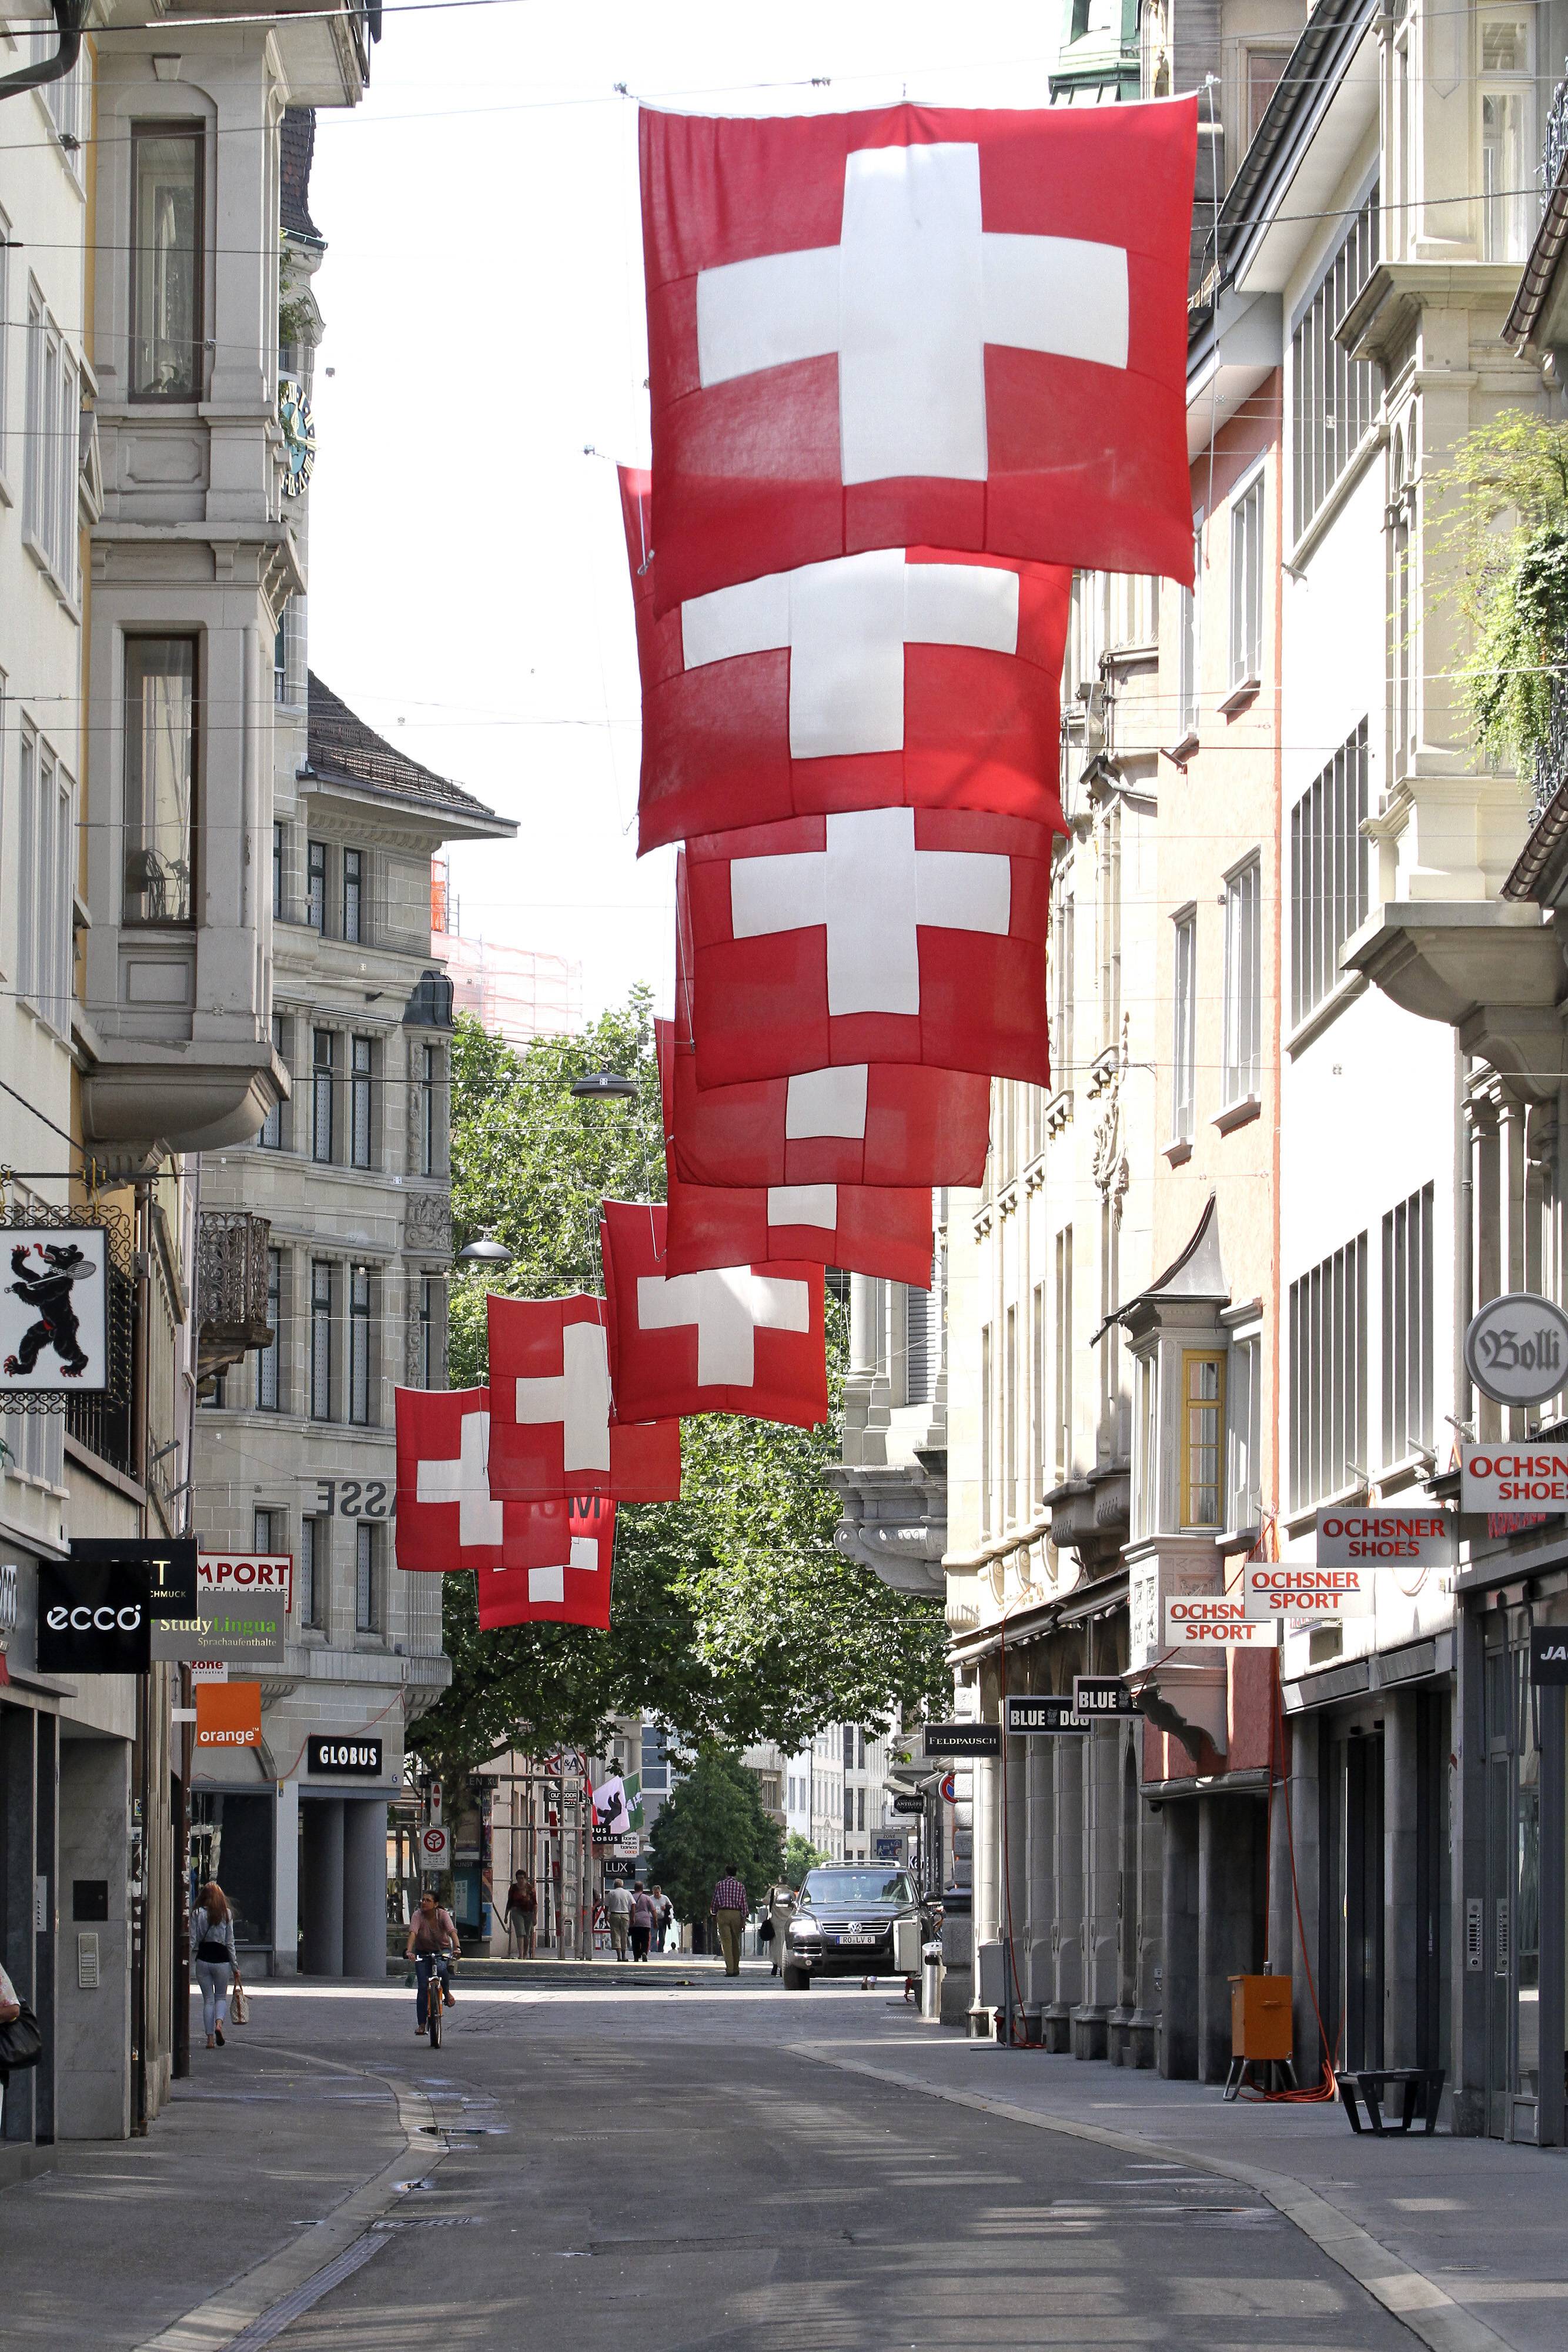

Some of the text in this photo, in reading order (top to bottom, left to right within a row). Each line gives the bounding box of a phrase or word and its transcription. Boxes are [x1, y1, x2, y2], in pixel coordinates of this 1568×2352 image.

[1479, 1329, 1560, 1371] Bolli
[1323, 1518, 1446, 1538] OCHSNER
[1348, 1541, 1420, 1558] SHOES
[1251, 1571, 1360, 1589] OCHSNER
[1269, 1592, 1343, 1609] SPORT
[46, 1604, 141, 1631] ecco
[1185, 1624, 1256, 1641] SPORT
[198, 1637, 277, 1647] Sprachaufenthalte
[1540, 1646, 1568, 1661] JA
[1078, 1692, 1116, 1708] BLUE
[1010, 1710, 1045, 1726] BLUE
[200, 1730, 255, 1745] orange
[319, 1745, 377, 1766] GLOBUS
[606, 1862, 628, 1873] LUX
